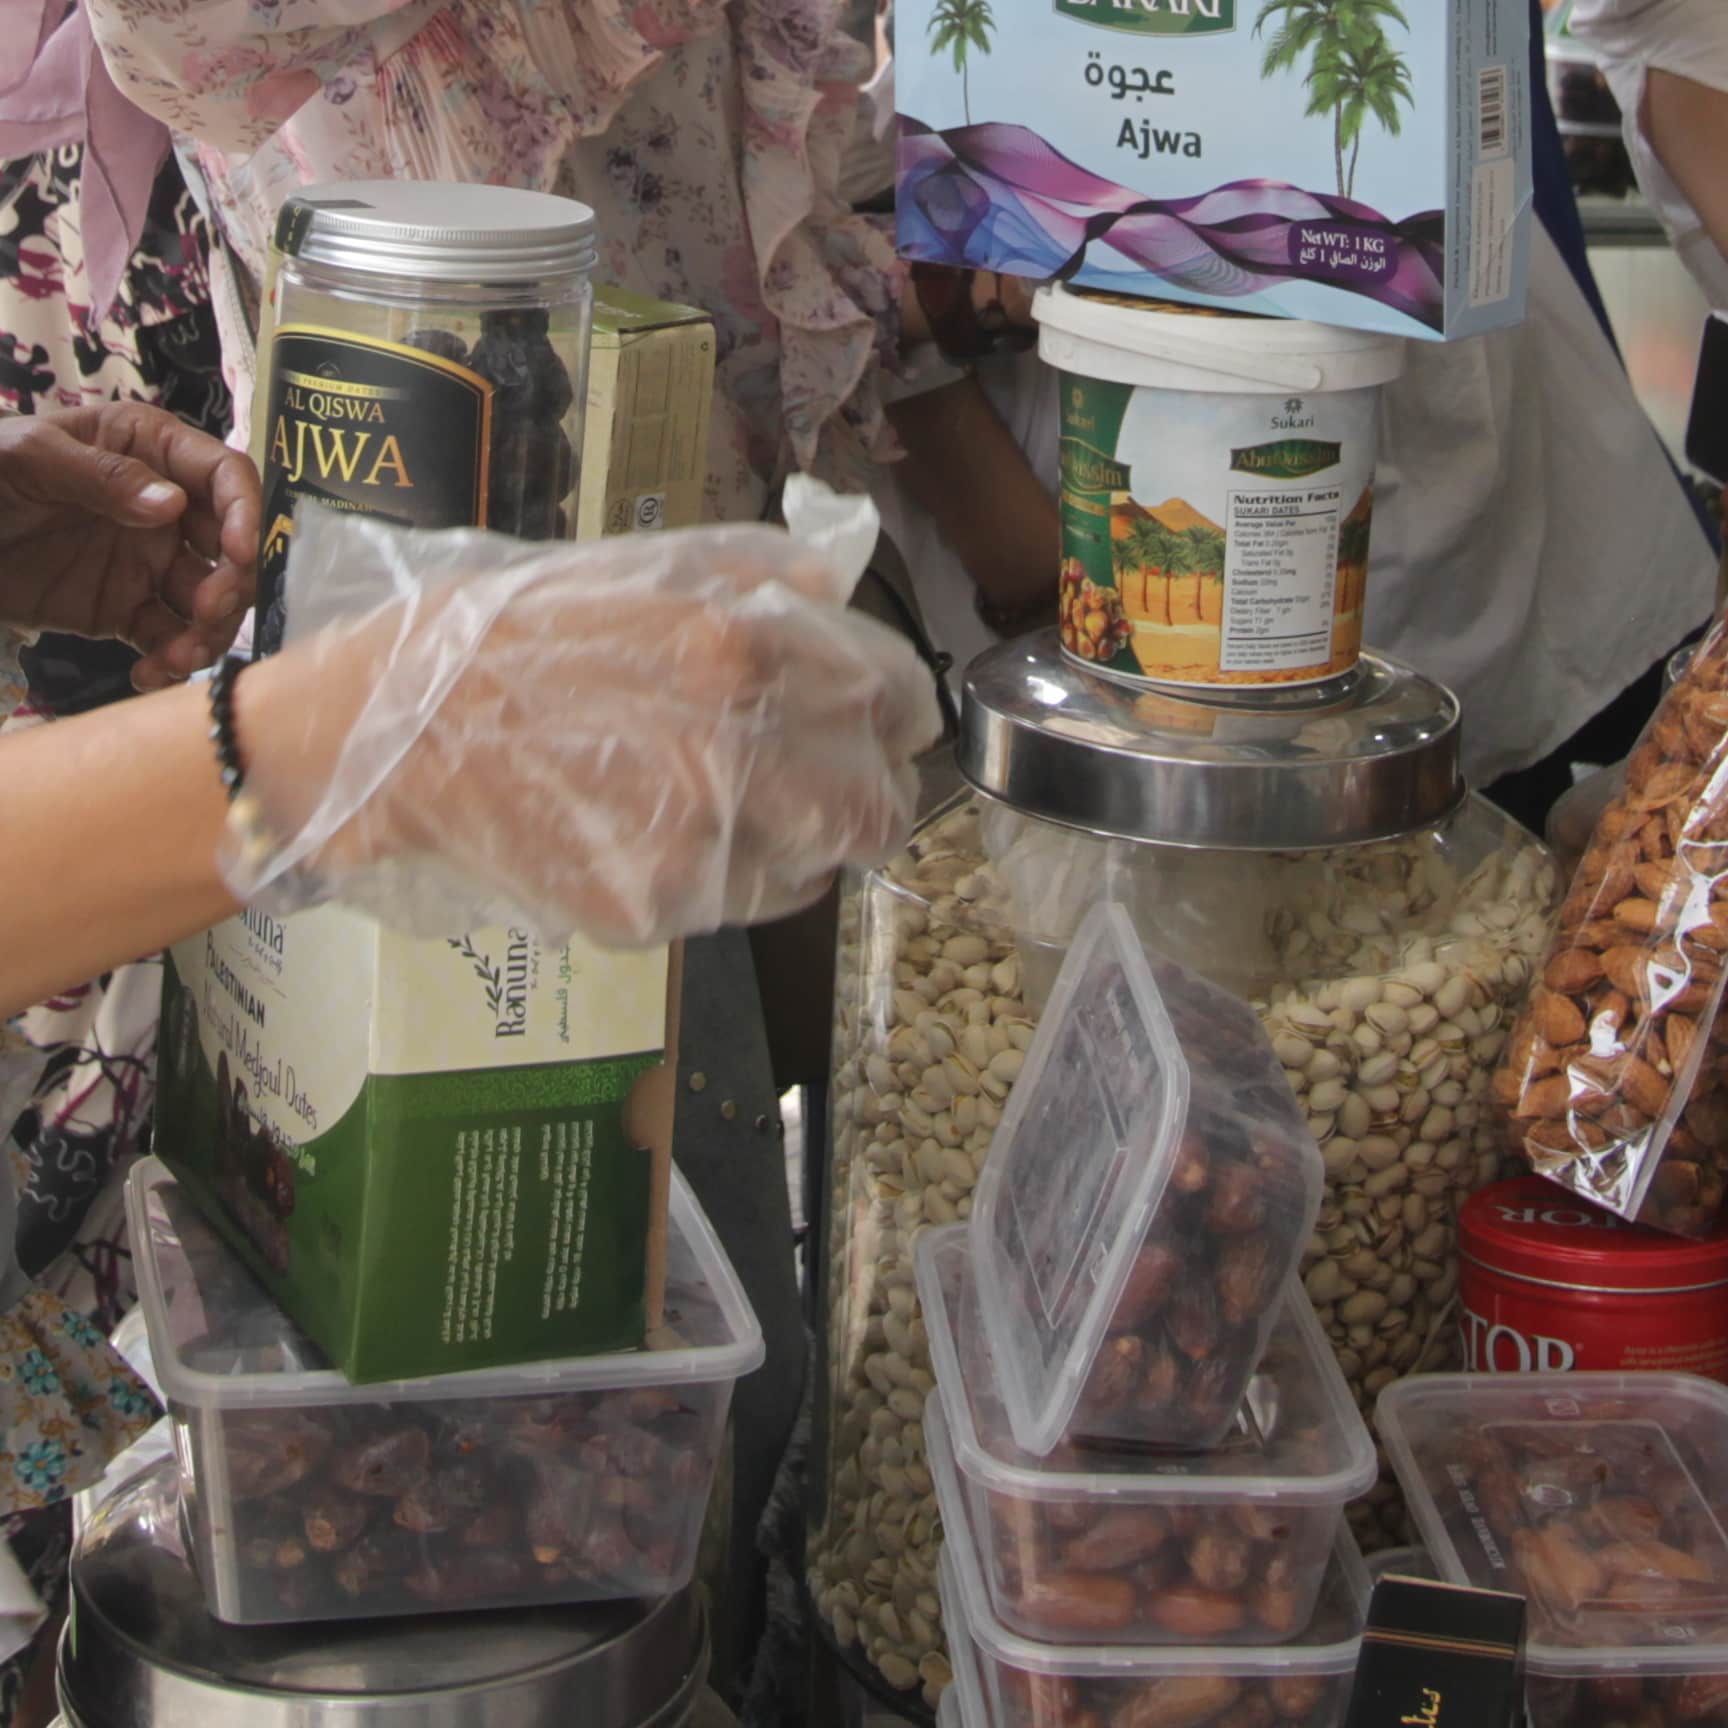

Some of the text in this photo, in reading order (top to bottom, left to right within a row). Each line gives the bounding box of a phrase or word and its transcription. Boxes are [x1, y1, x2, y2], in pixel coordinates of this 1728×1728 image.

[1084, 50, 1176, 101] عجوة
[1116, 118, 1204, 165] Ajwa
[1363, 238, 1385, 253] KG
[285, 387, 385, 424] AL QISWA
[1270, 415, 1315, 430] Sukari
[270, 415, 414, 487] AJWA
[1234, 490, 1340, 505] Nutrition Facts
[1272, 506, 1300, 515] DATES
[206, 930, 266, 1029] PALESTINIAN
[235, 1022, 283, 1099] Medjoul
[285, 1064, 319, 1131] Dates
[1458, 1310, 1576, 1373] TOR
[1400, 1687, 1443, 1728] tes
